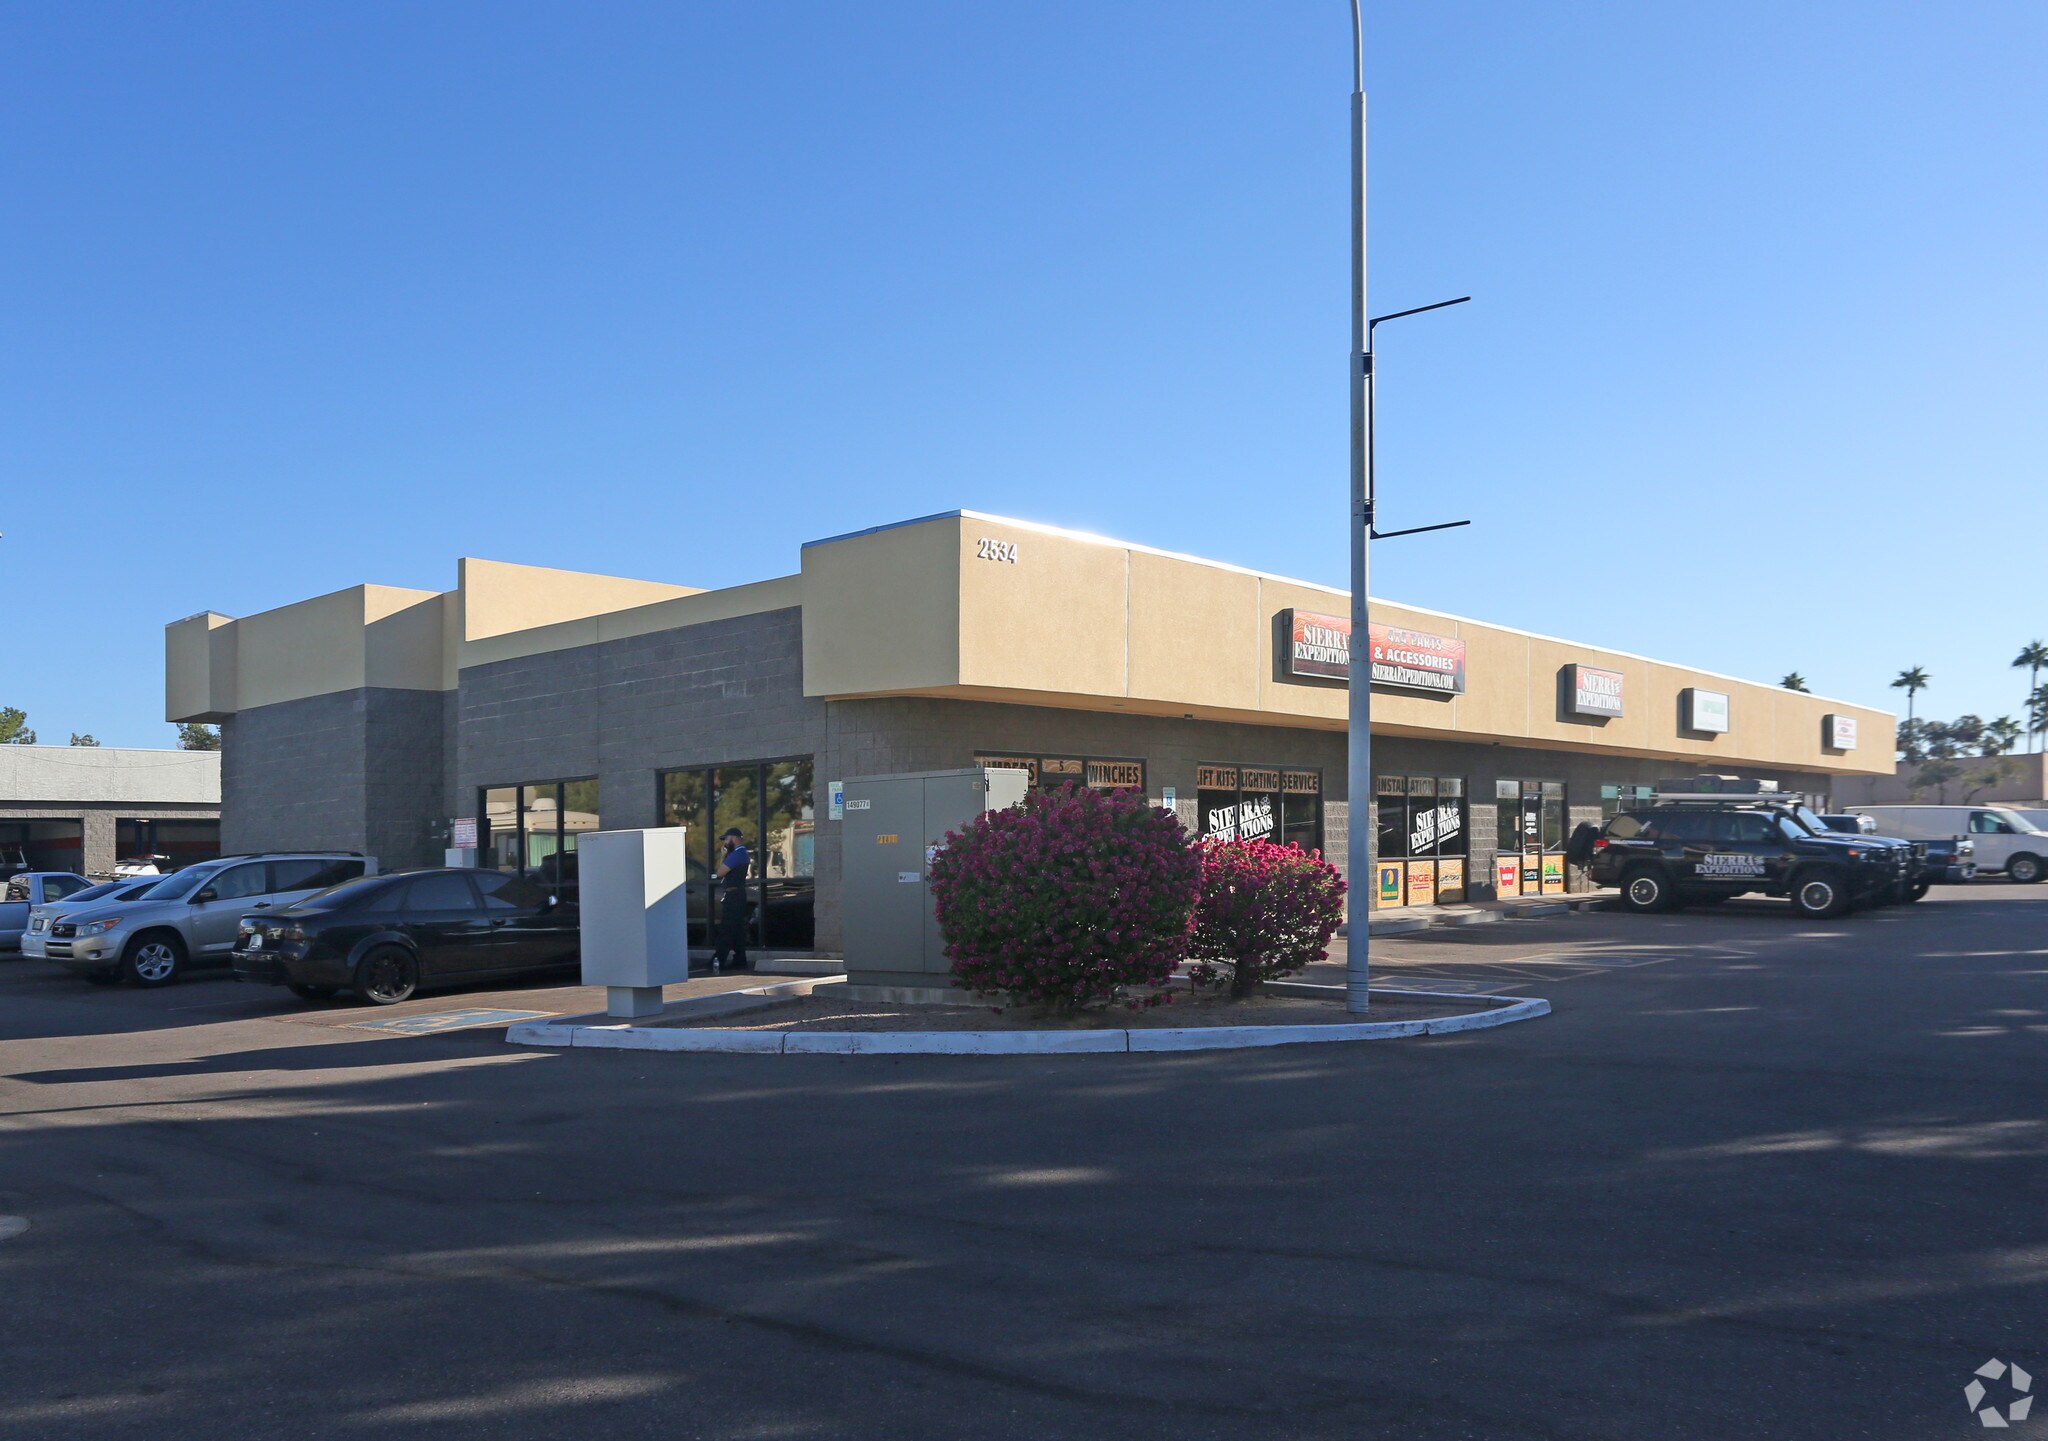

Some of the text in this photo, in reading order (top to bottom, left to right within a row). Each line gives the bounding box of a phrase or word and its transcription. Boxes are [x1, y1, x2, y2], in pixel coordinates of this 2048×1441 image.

[977, 538, 1017, 564] 2534
[1304, 624, 1348, 650] SIERRA
[1410, 632, 1442, 651] PARTS
[1295, 641, 1350, 665] EXPEDITION
[1374, 646, 1454, 670] & ACCESSORIES
[1583, 671, 1615, 695] SIERRA
[1576, 689, 1621, 710] EXPEDITIONS
[1088, 765, 1139, 784] WINCHES
[1197, 769, 1236, 787] IFT KITS
[1241, 771, 1277, 789] LIGHTING
[1282, 773, 1317, 790] SERVICE
[1378, 777, 1433, 793] INSTALATION
[1410, 815, 1460, 849] EXPETIONS
[1695, 864, 1766, 874] EXPEDITIONS
[1704, 854, 1753, 865] SIERRA
[1408, 874, 1434, 882] ENGEL
